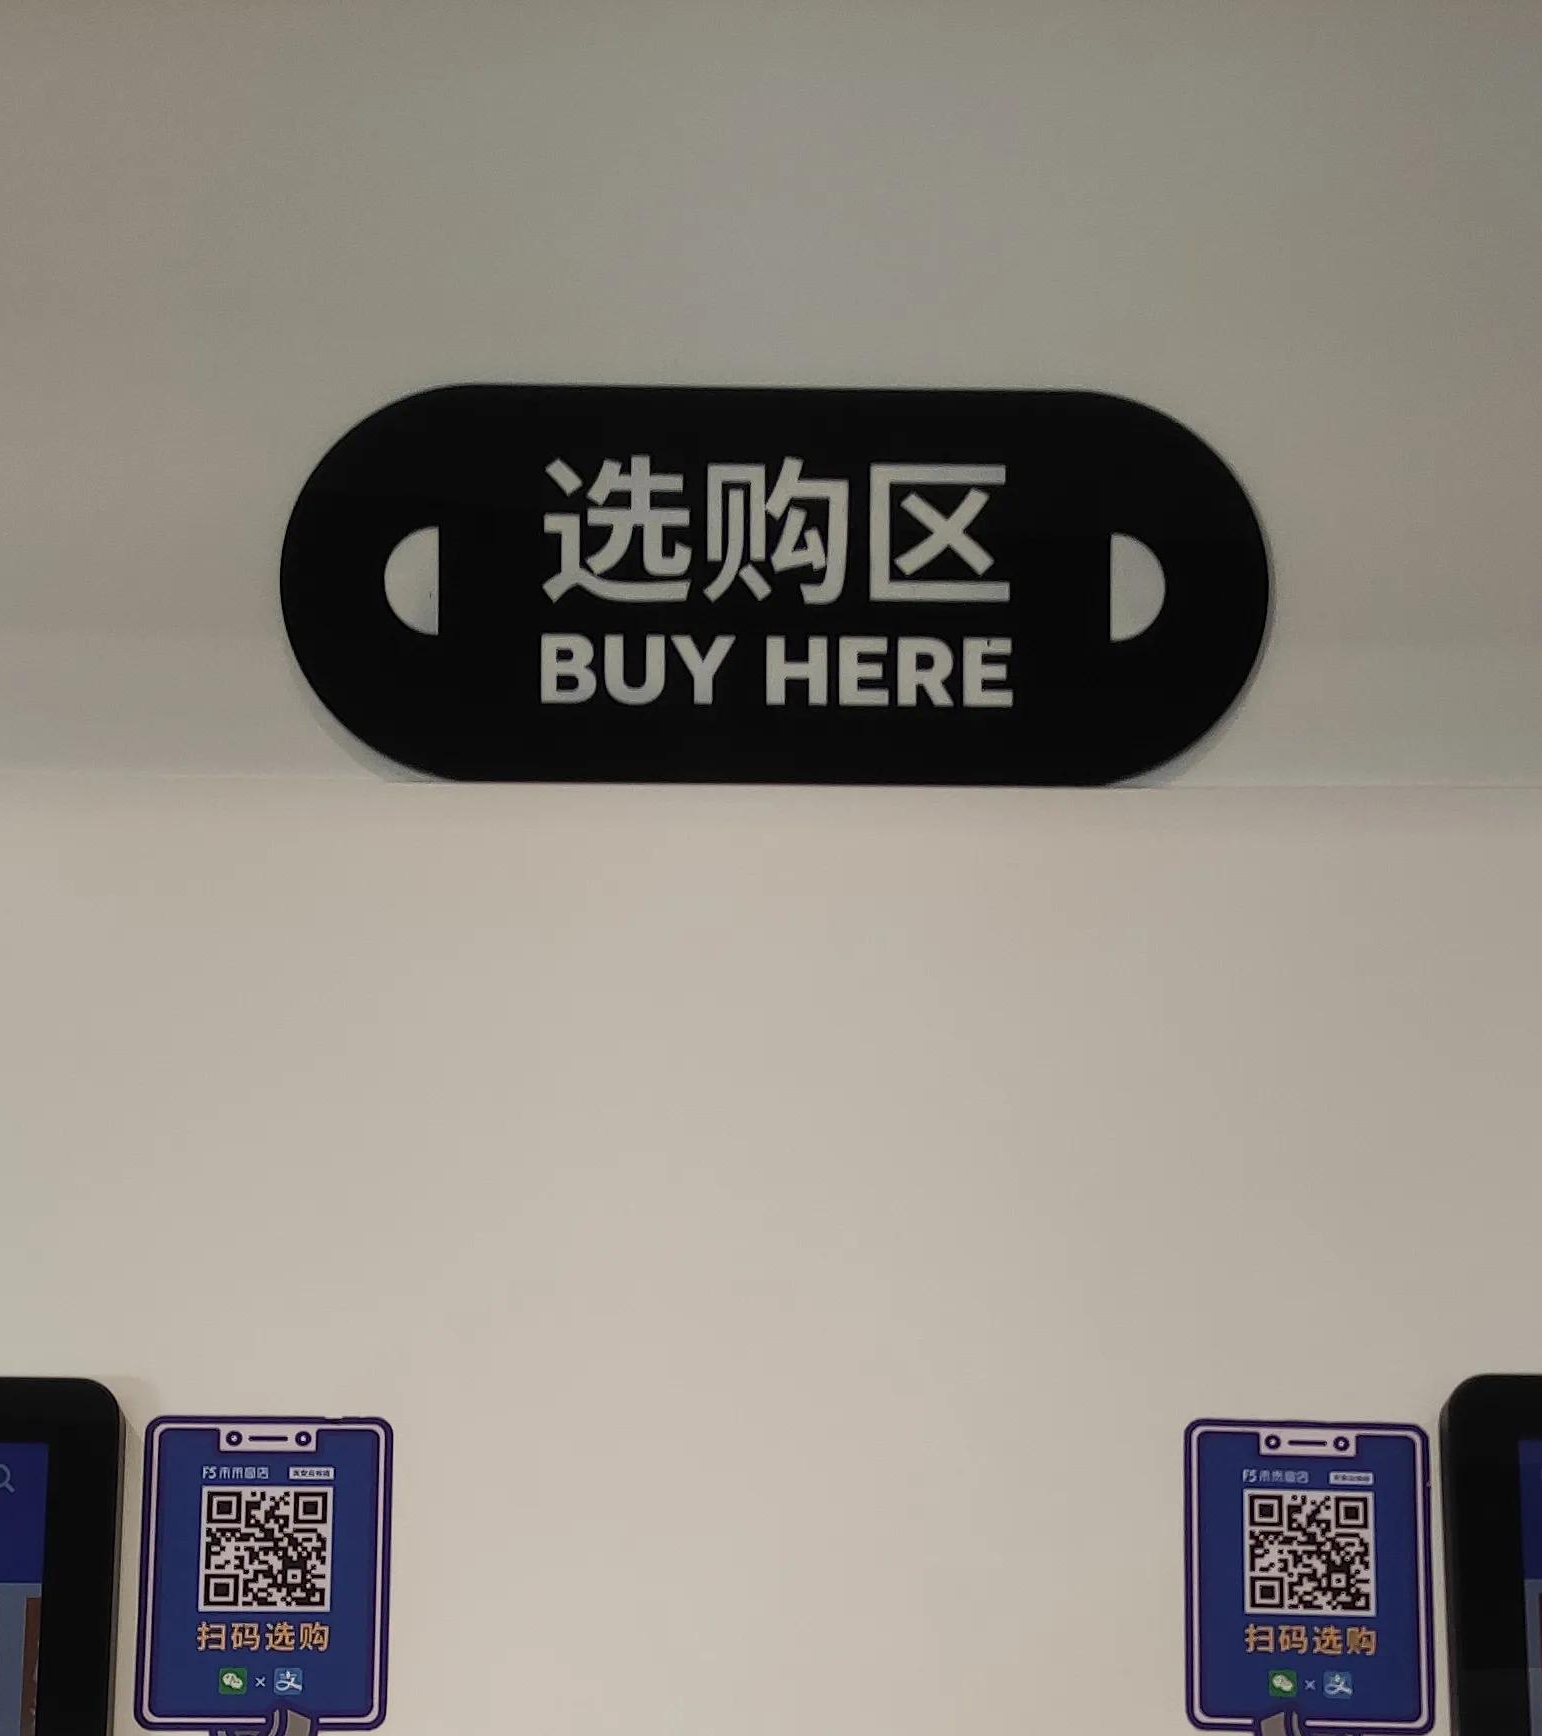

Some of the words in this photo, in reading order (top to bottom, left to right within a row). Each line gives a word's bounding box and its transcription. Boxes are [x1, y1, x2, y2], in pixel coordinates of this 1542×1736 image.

[543, 455, 1012, 604] 选购区
[540, 634, 735, 705] BUY
[765, 636, 1014, 708] HERE
[197, 1621, 330, 1651] 扫码选购
[1245, 1624, 1376, 1655] 扫码选购
